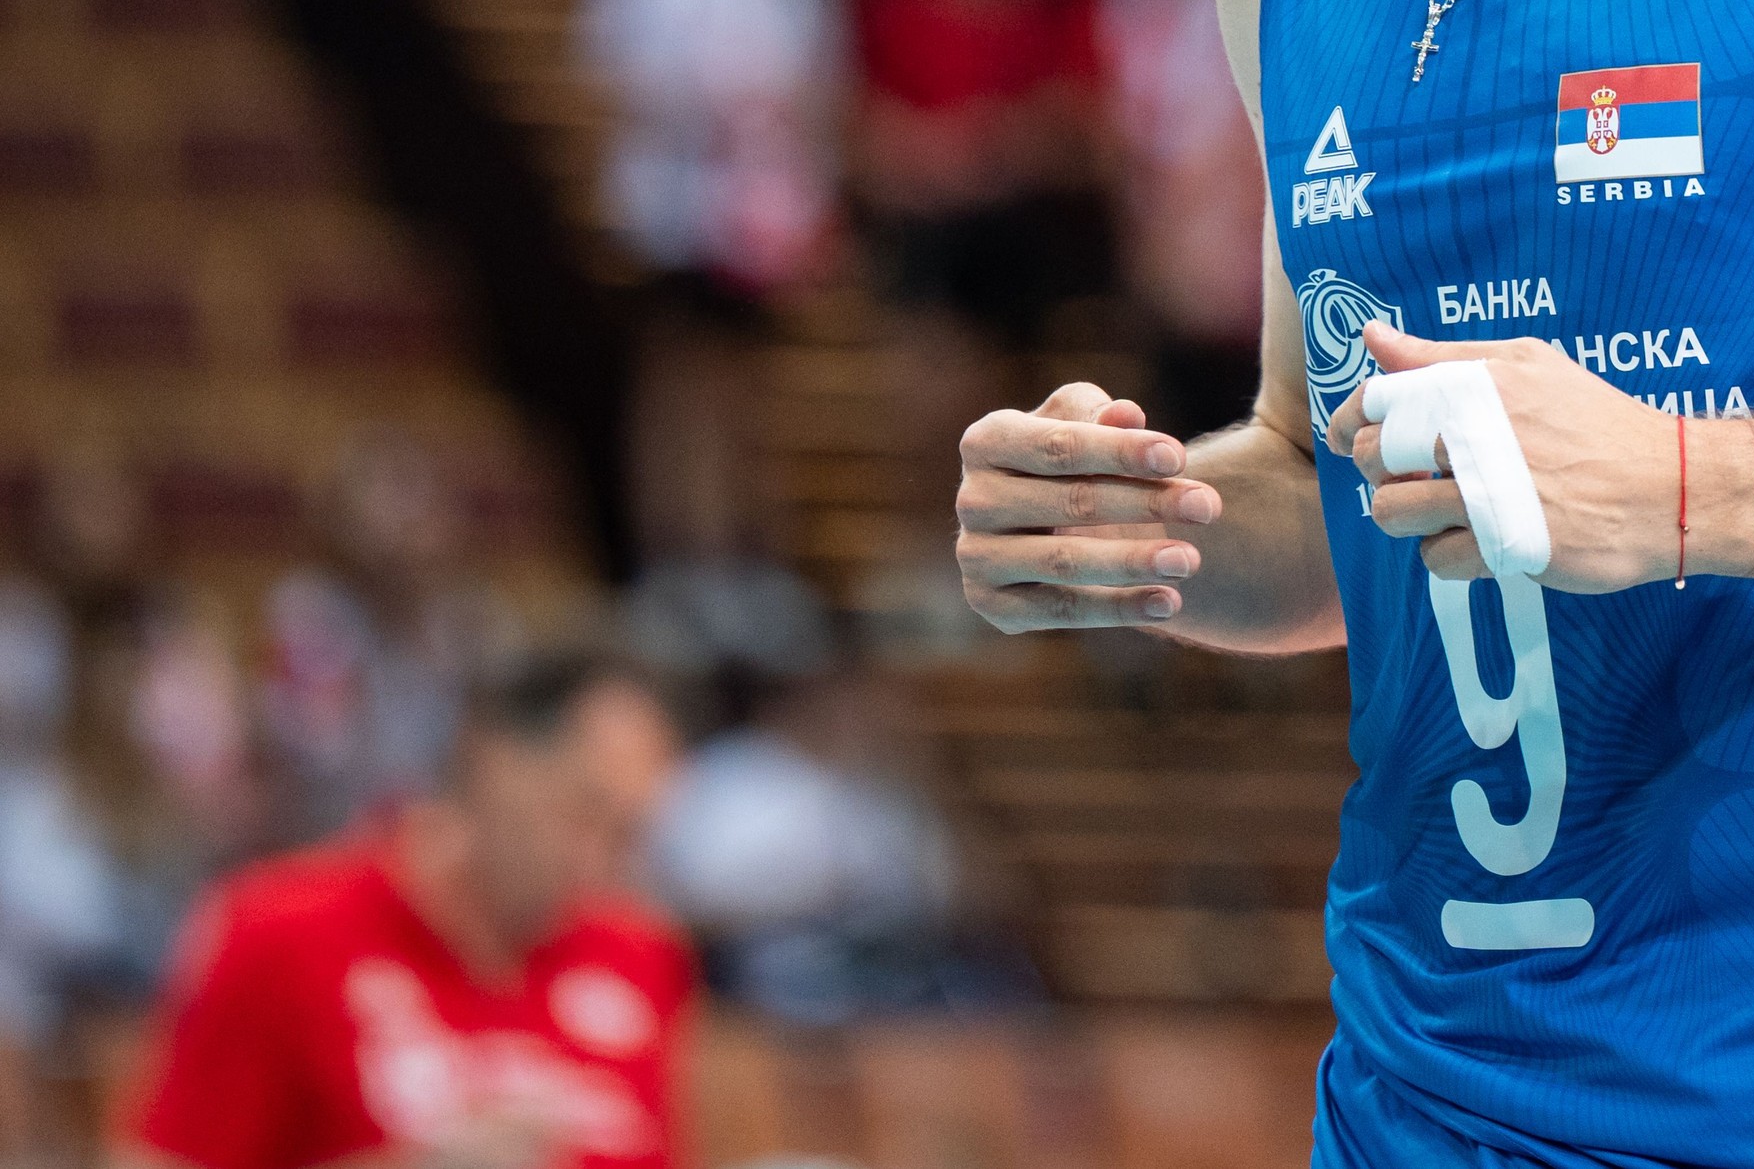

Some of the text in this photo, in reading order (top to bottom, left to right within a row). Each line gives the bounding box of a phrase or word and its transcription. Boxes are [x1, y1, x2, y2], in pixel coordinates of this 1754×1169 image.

[1292, 172, 1377, 228] PEAK
[1557, 178, 1705, 205] SERBIA
[1437, 277, 1557, 325] БАНКА
[1429, 572, 1567, 876] 9
